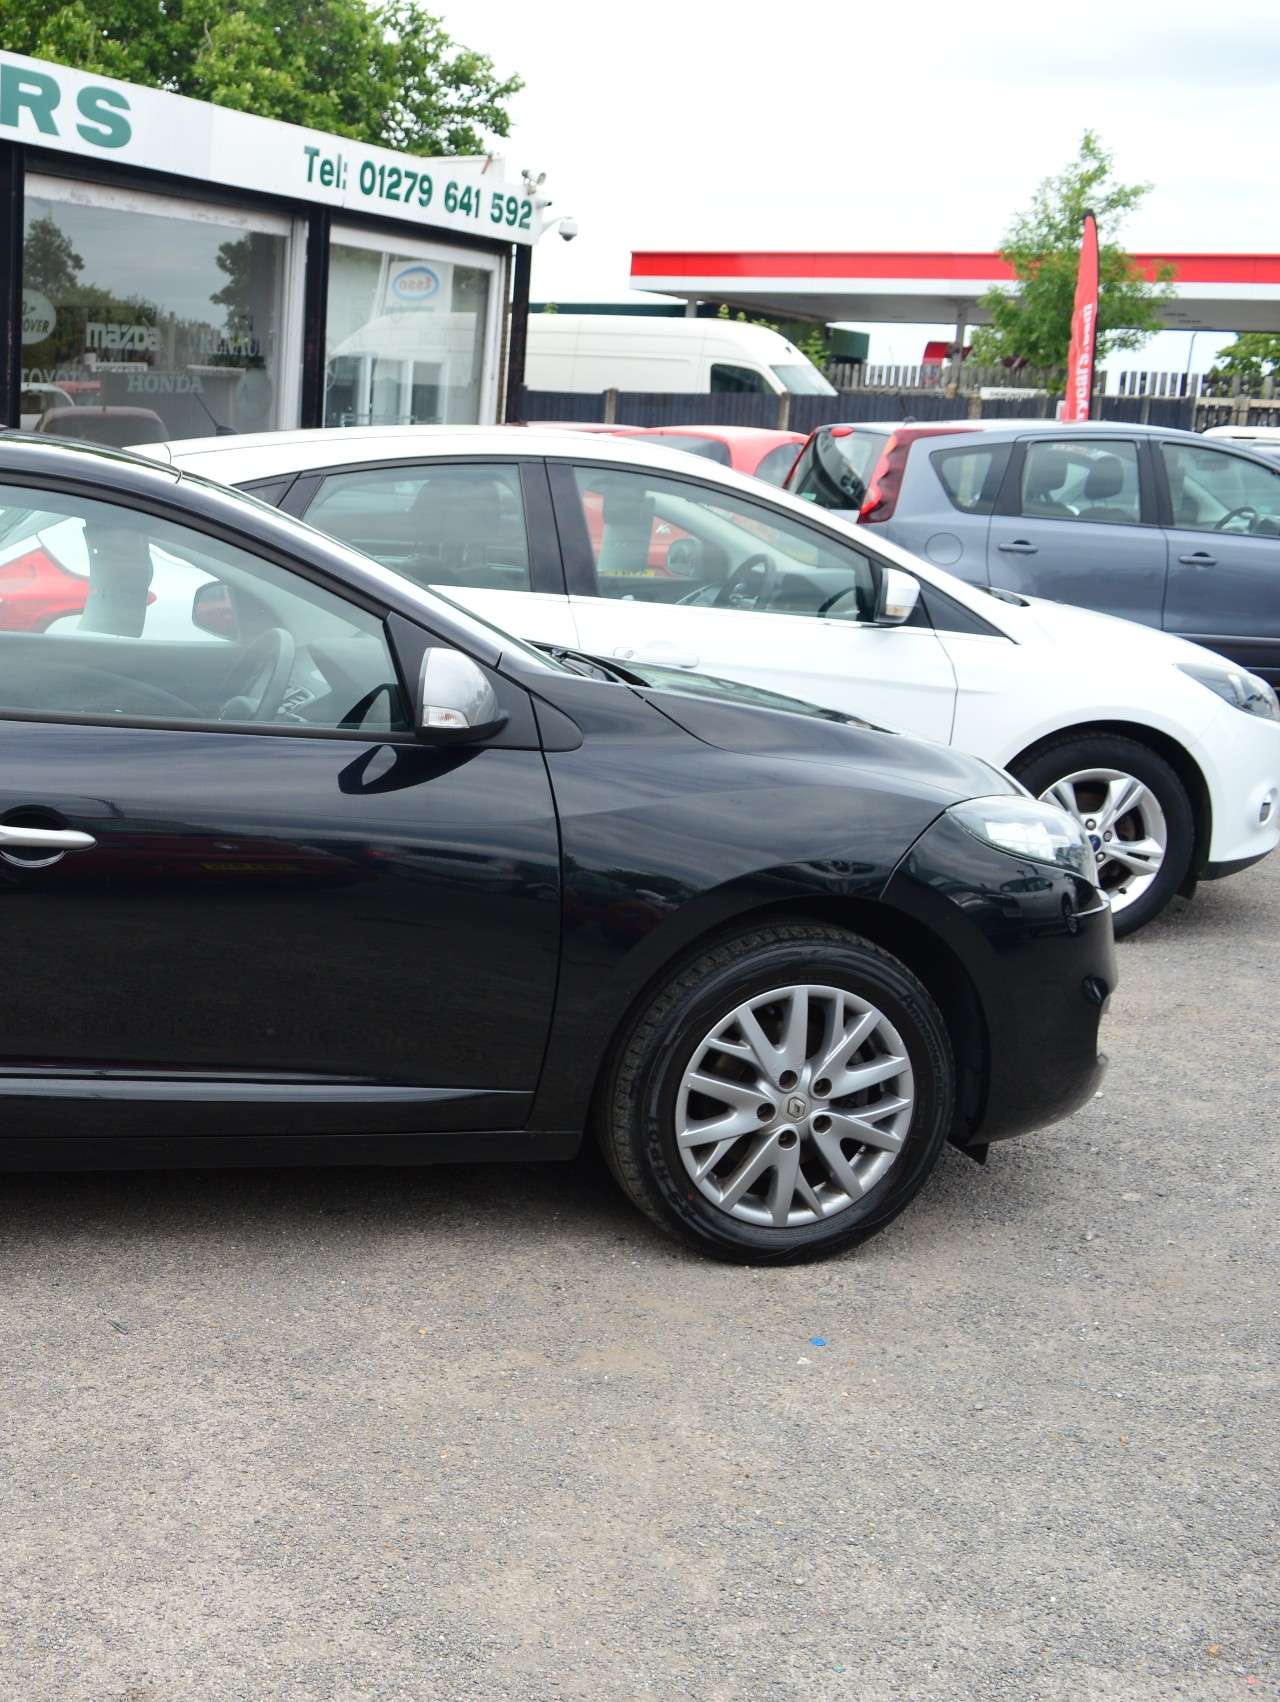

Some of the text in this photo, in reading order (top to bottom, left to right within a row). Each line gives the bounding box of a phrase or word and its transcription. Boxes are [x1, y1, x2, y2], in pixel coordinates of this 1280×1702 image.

[304, 145, 533, 230] Tel: 01279 641 592
[127, 373, 205, 393] HONDA
